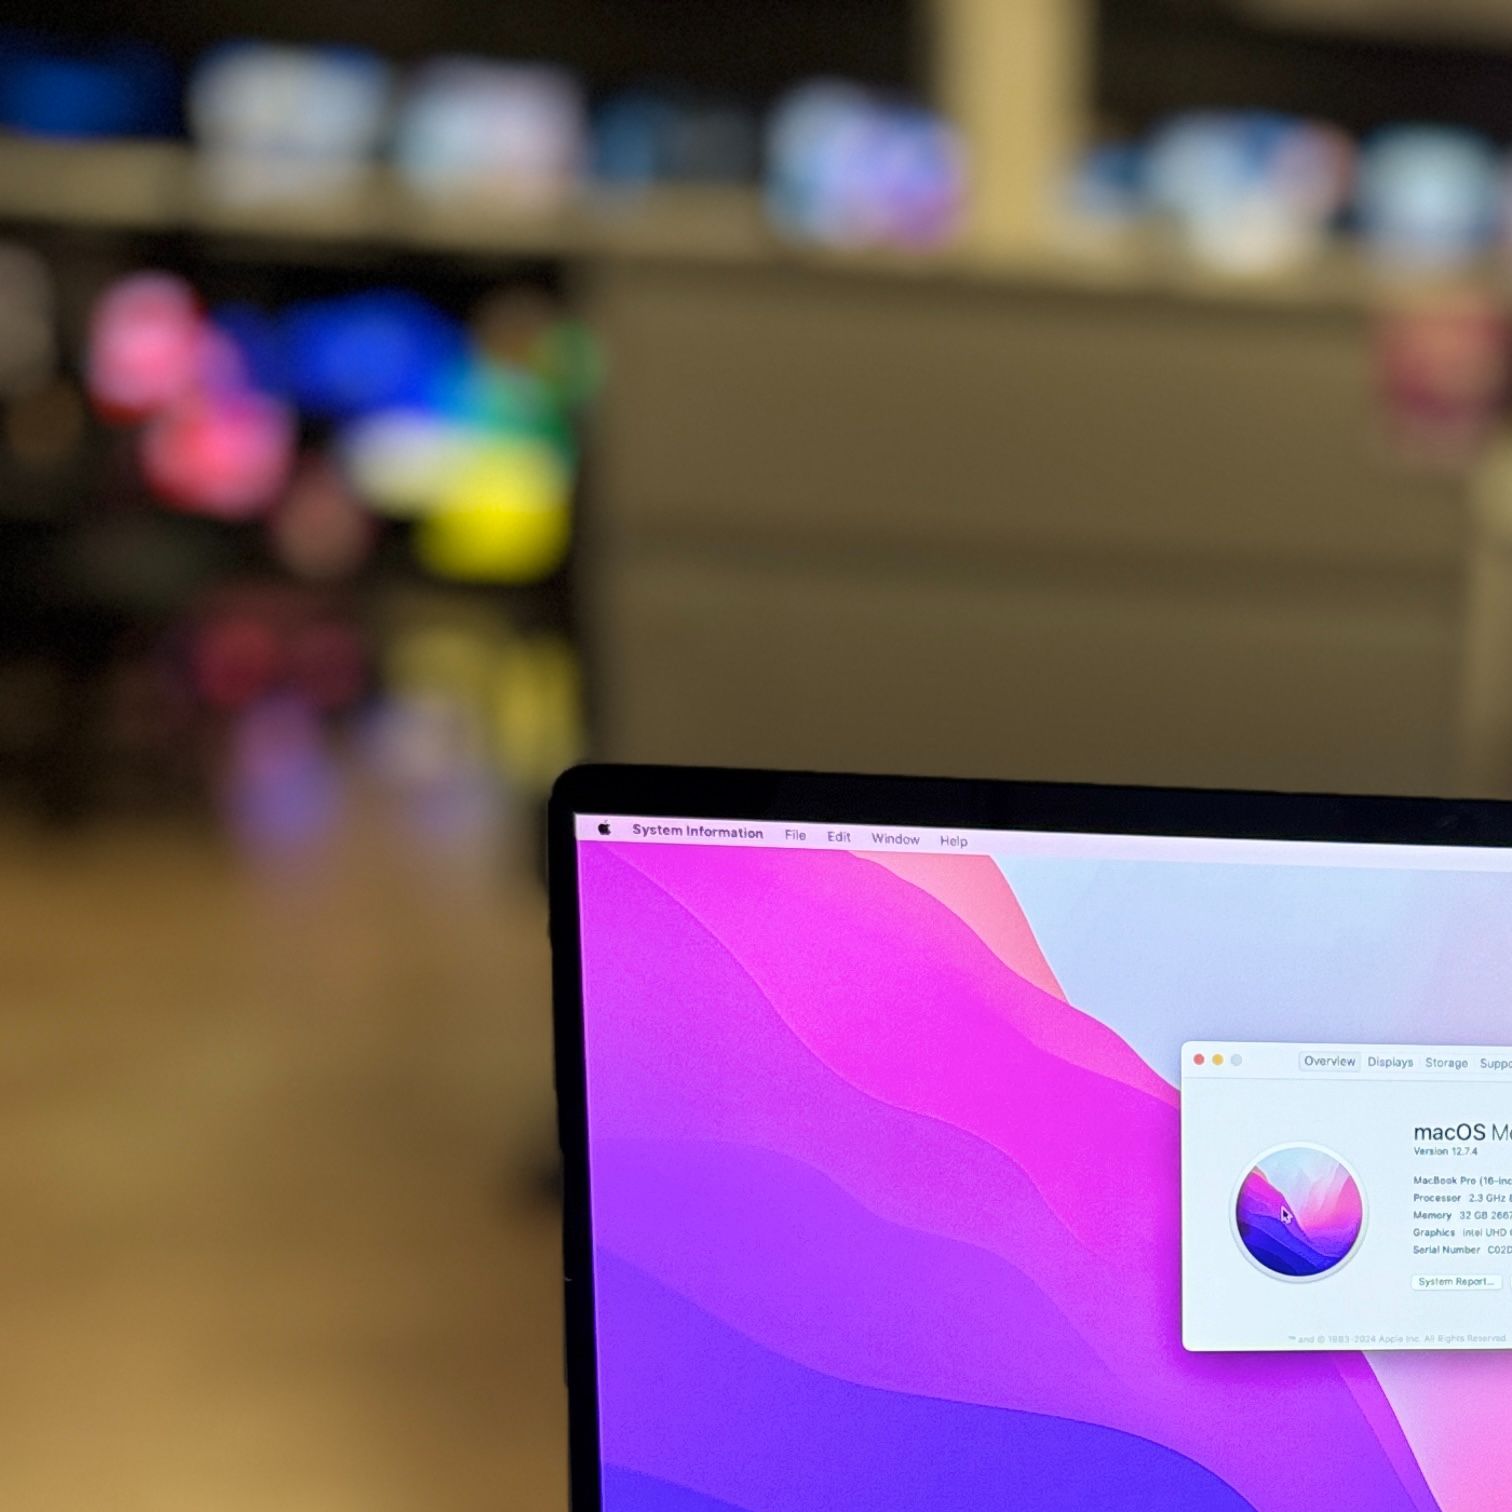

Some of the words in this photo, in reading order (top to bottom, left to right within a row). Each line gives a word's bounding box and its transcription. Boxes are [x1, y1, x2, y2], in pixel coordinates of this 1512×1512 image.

[632, 823, 684, 838] System
[686, 825, 764, 839] Information
[785, 829, 806, 841] File
[827, 831, 851, 843] Edit
[872, 832, 920, 846] Window
[940, 835, 968, 848] Help
[1304, 1055, 1356, 1067] Overview
[1367, 1057, 1414, 1068] Displays
[1425, 1057, 1469, 1070] Storage
[1414, 1123, 1486, 1141] macOS
[1414, 1147, 1449, 1156] Version
[1452, 1147, 1478, 1156] 12.7.4
[1413, 1176, 1457, 1185] MacBook
[1460, 1176, 1476, 1185] Pro
[1413, 1194, 1461, 1203] Processor
[1469, 1194, 1484, 1203] 2.3
[1486, 1194, 1506, 1203] GHz
[1413, 1211, 1452, 1220] Memory
[1459, 1211, 1472, 1220] 32
[1474, 1211, 1488, 1220] GB
[1413, 1228, 1455, 1238] Graphics
[1463, 1228, 1483, 1238] Intel
[1485, 1228, 1507, 1238] UHD
[1413, 1245, 1440, 1254] Serial
[1443, 1245, 1481, 1254] Number
[1418, 1277, 1453, 1287] System
